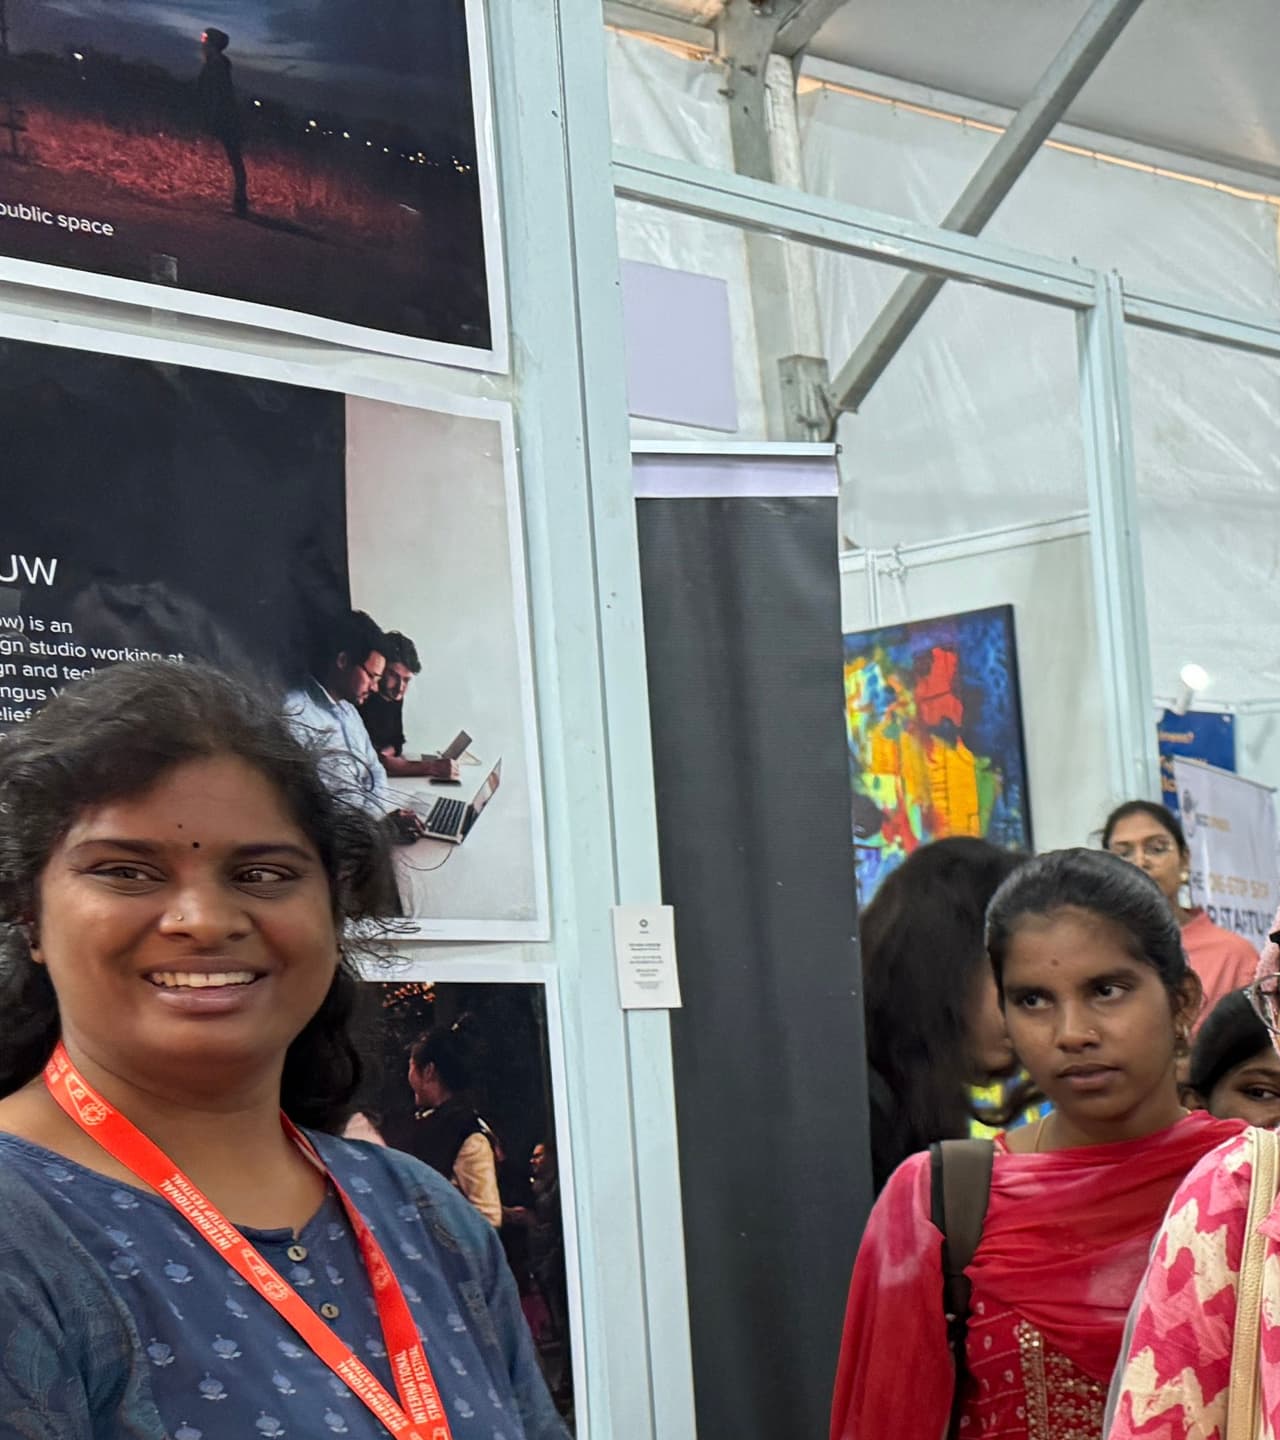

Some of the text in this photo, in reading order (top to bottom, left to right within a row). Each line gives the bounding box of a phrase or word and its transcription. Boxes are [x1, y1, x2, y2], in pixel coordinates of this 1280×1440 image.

[57, 214, 115, 236] space
[29, 615, 45, 631] is
[50, 620, 73, 634] an
[29, 641, 87, 658] studio
[22, 664, 58, 679] and
[159, 1178, 233, 1252] INTERNATIONAL
[170, 1172, 242, 1245] STARTUP FESTIVAL
[336, 1360, 403, 1432] INTERNATIONAL
[346, 1356, 410, 1428] STARTUP FESTIVAL
[392, 1349, 429, 1425] INTERNATIONAL
[408, 1344, 443, 1421] STARTUP FESTIVAL
